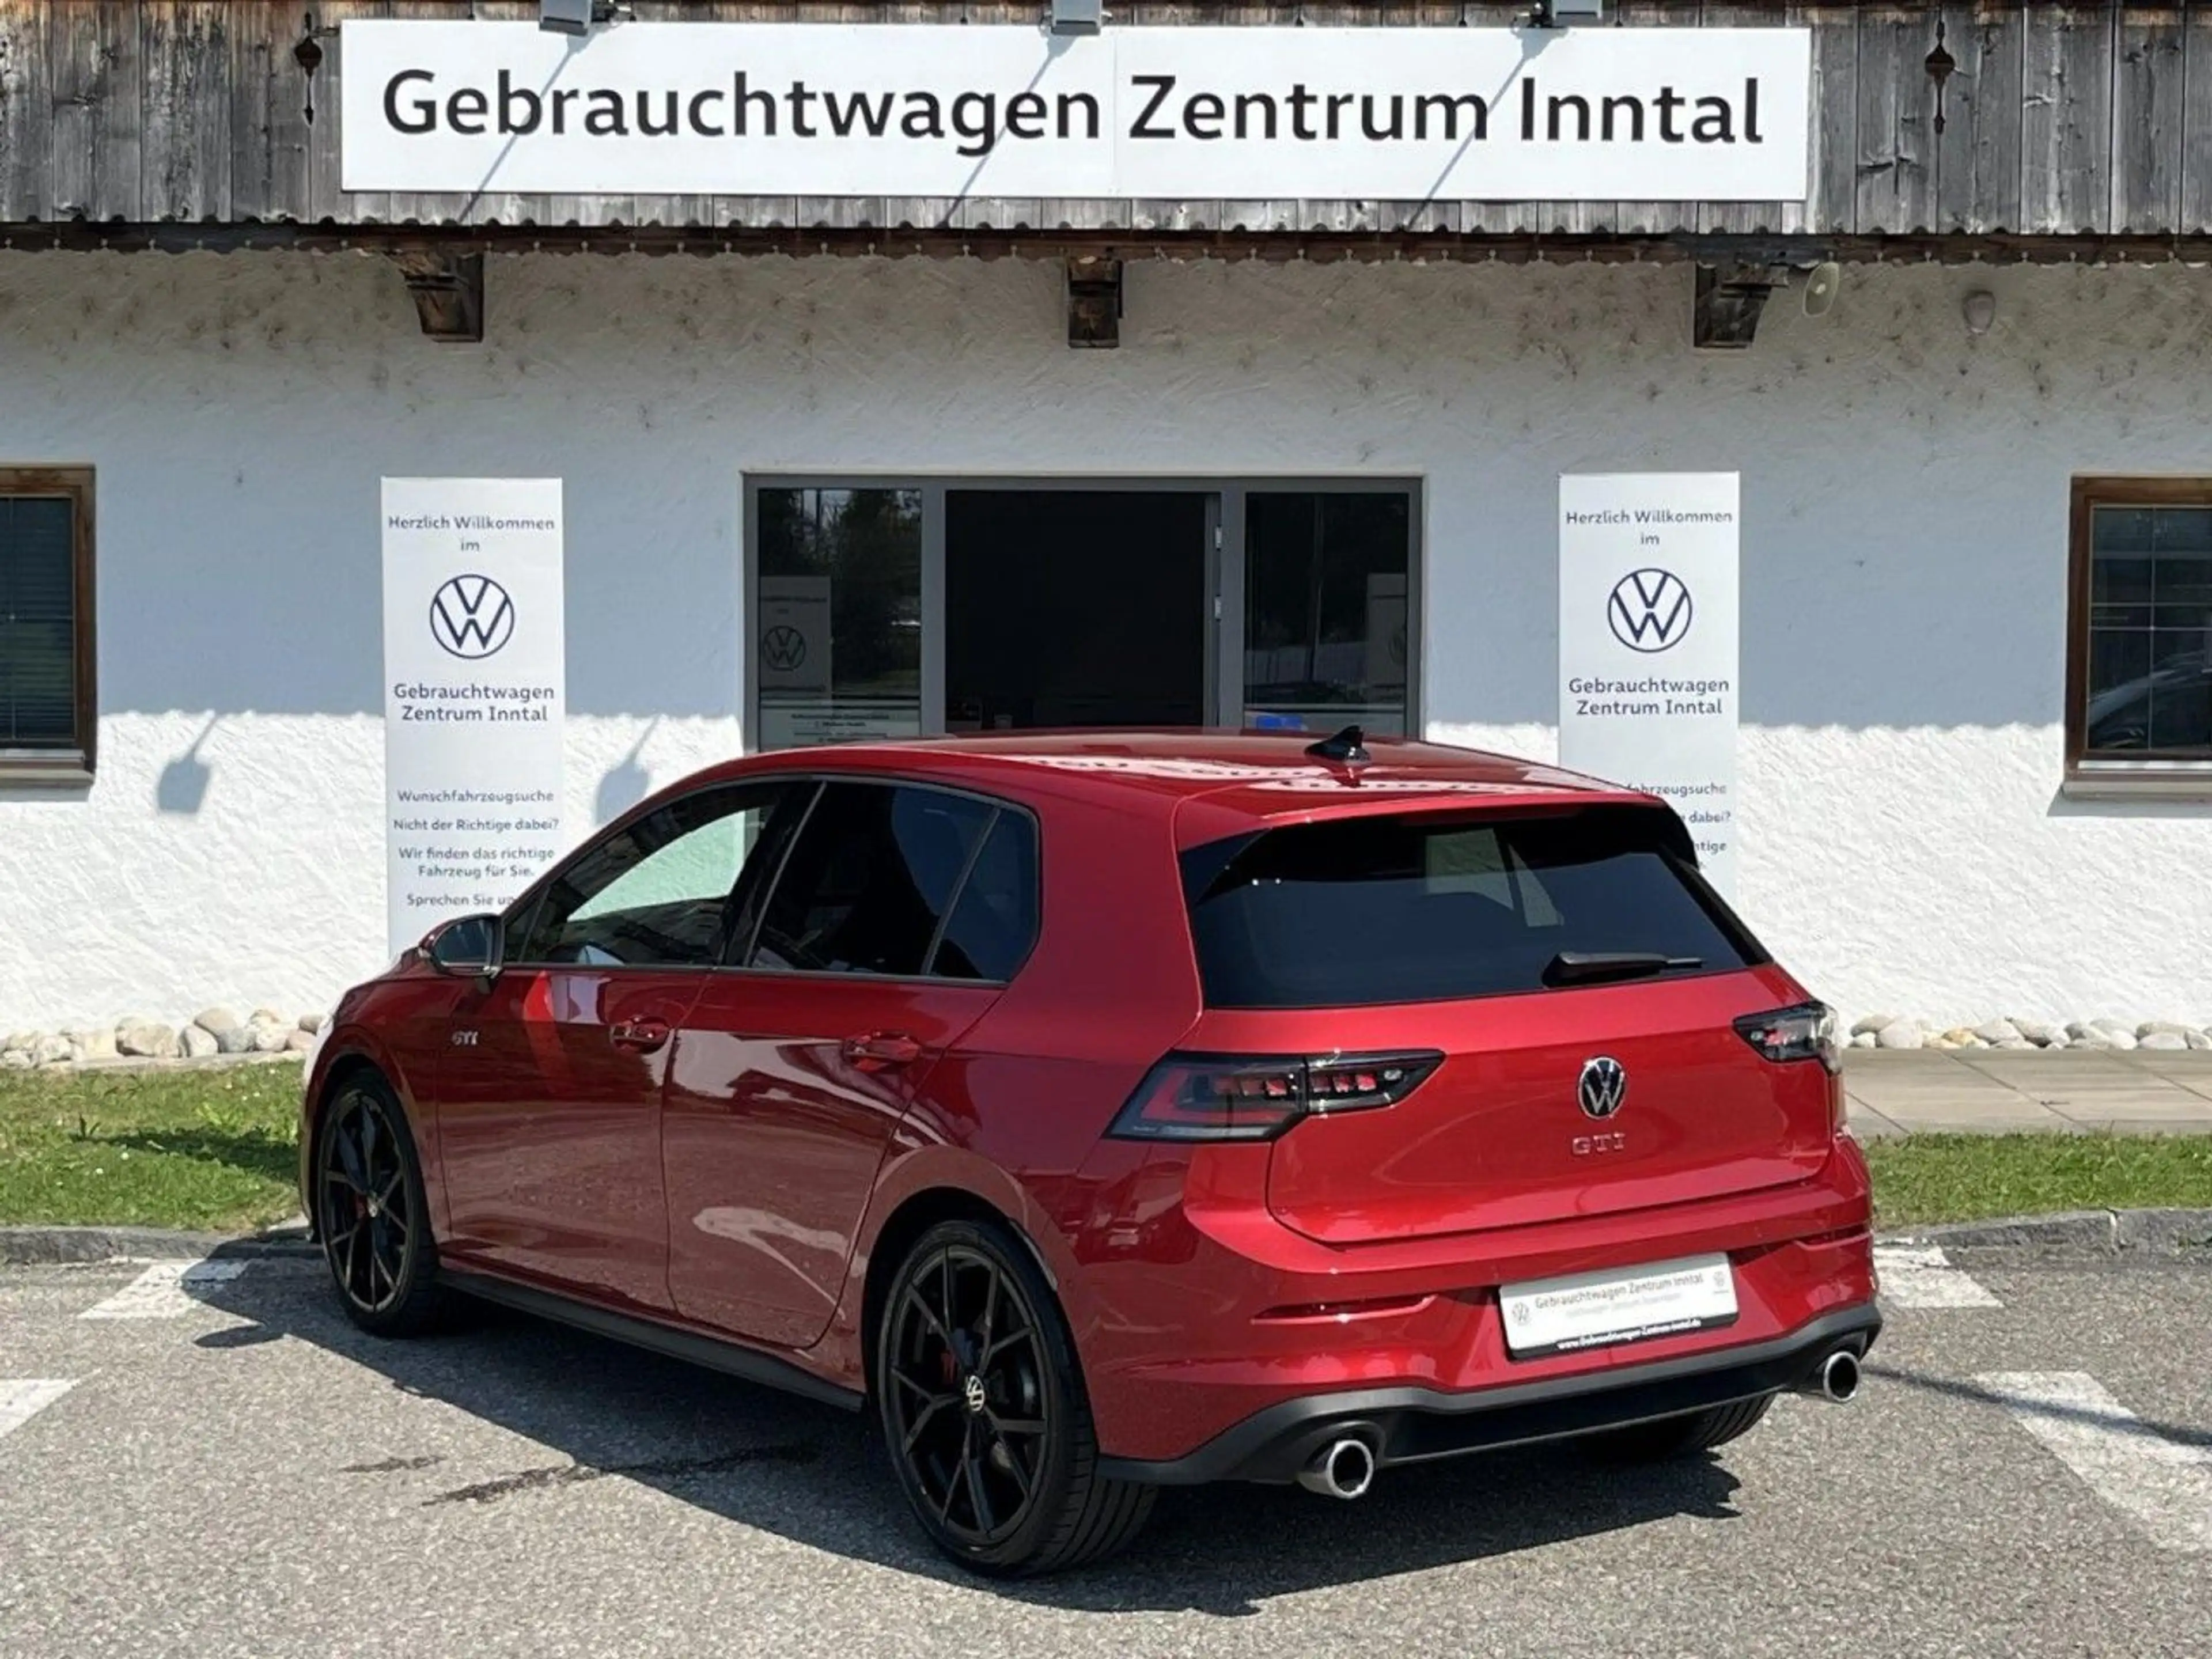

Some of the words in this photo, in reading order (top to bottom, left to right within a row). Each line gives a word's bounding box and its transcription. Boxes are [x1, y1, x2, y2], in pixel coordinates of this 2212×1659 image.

[382, 69, 1099, 157] Gebrauchtwagen
[1130, 75, 1488, 141] Zentrum
[1521, 77, 1764, 144] Inntal
[388, 516, 450, 529] Herzlich
[454, 516, 555, 530] Willkommen
[1566, 510, 1630, 524] Herzlich
[1634, 510, 1732, 524] Willkommen
[461, 540, 480, 551] im
[1641, 533, 1660, 545] im
[430, 574, 514, 659] VW
[1608, 568, 1692, 653] VW
[394, 683, 554, 703] Gebrauchtwagen
[1569, 677, 1729, 695] Gebrauchtwagen
[402, 706, 483, 721] Zentrum
[489, 706, 547, 721] Inntal
[1576, 700, 1660, 715] Zentrum
[1666, 699, 1722, 714] Inntal
[397, 790, 554, 805] Wunschfahrzeugsuche
[1689, 810, 1730, 823] dabei?
[393, 819, 427, 831] Nicht
[431, 819, 453, 831] der
[456, 819, 512, 833] Richtige
[515, 819, 559, 830] dabei?
[399, 847, 422, 859] Wir
[427, 847, 469, 859] finden
[472, 848, 497, 859] das
[501, 848, 554, 862] richtige
[418, 866, 481, 879] Fahrzeug
[485, 865, 505, 876] für
[510, 866, 535, 876] Sie.
[407, 895, 468, 907] Sprechen
[474, 895, 493, 906] Sie
[452, 1031, 478, 1046] GTI
[1578, 1056, 1626, 1120] VW
[1572, 1131, 1626, 1154] GTI
[1535, 1286, 1627, 1309] Gebrauchtwagen
[1629, 1277, 1671, 1295] Zentrum
